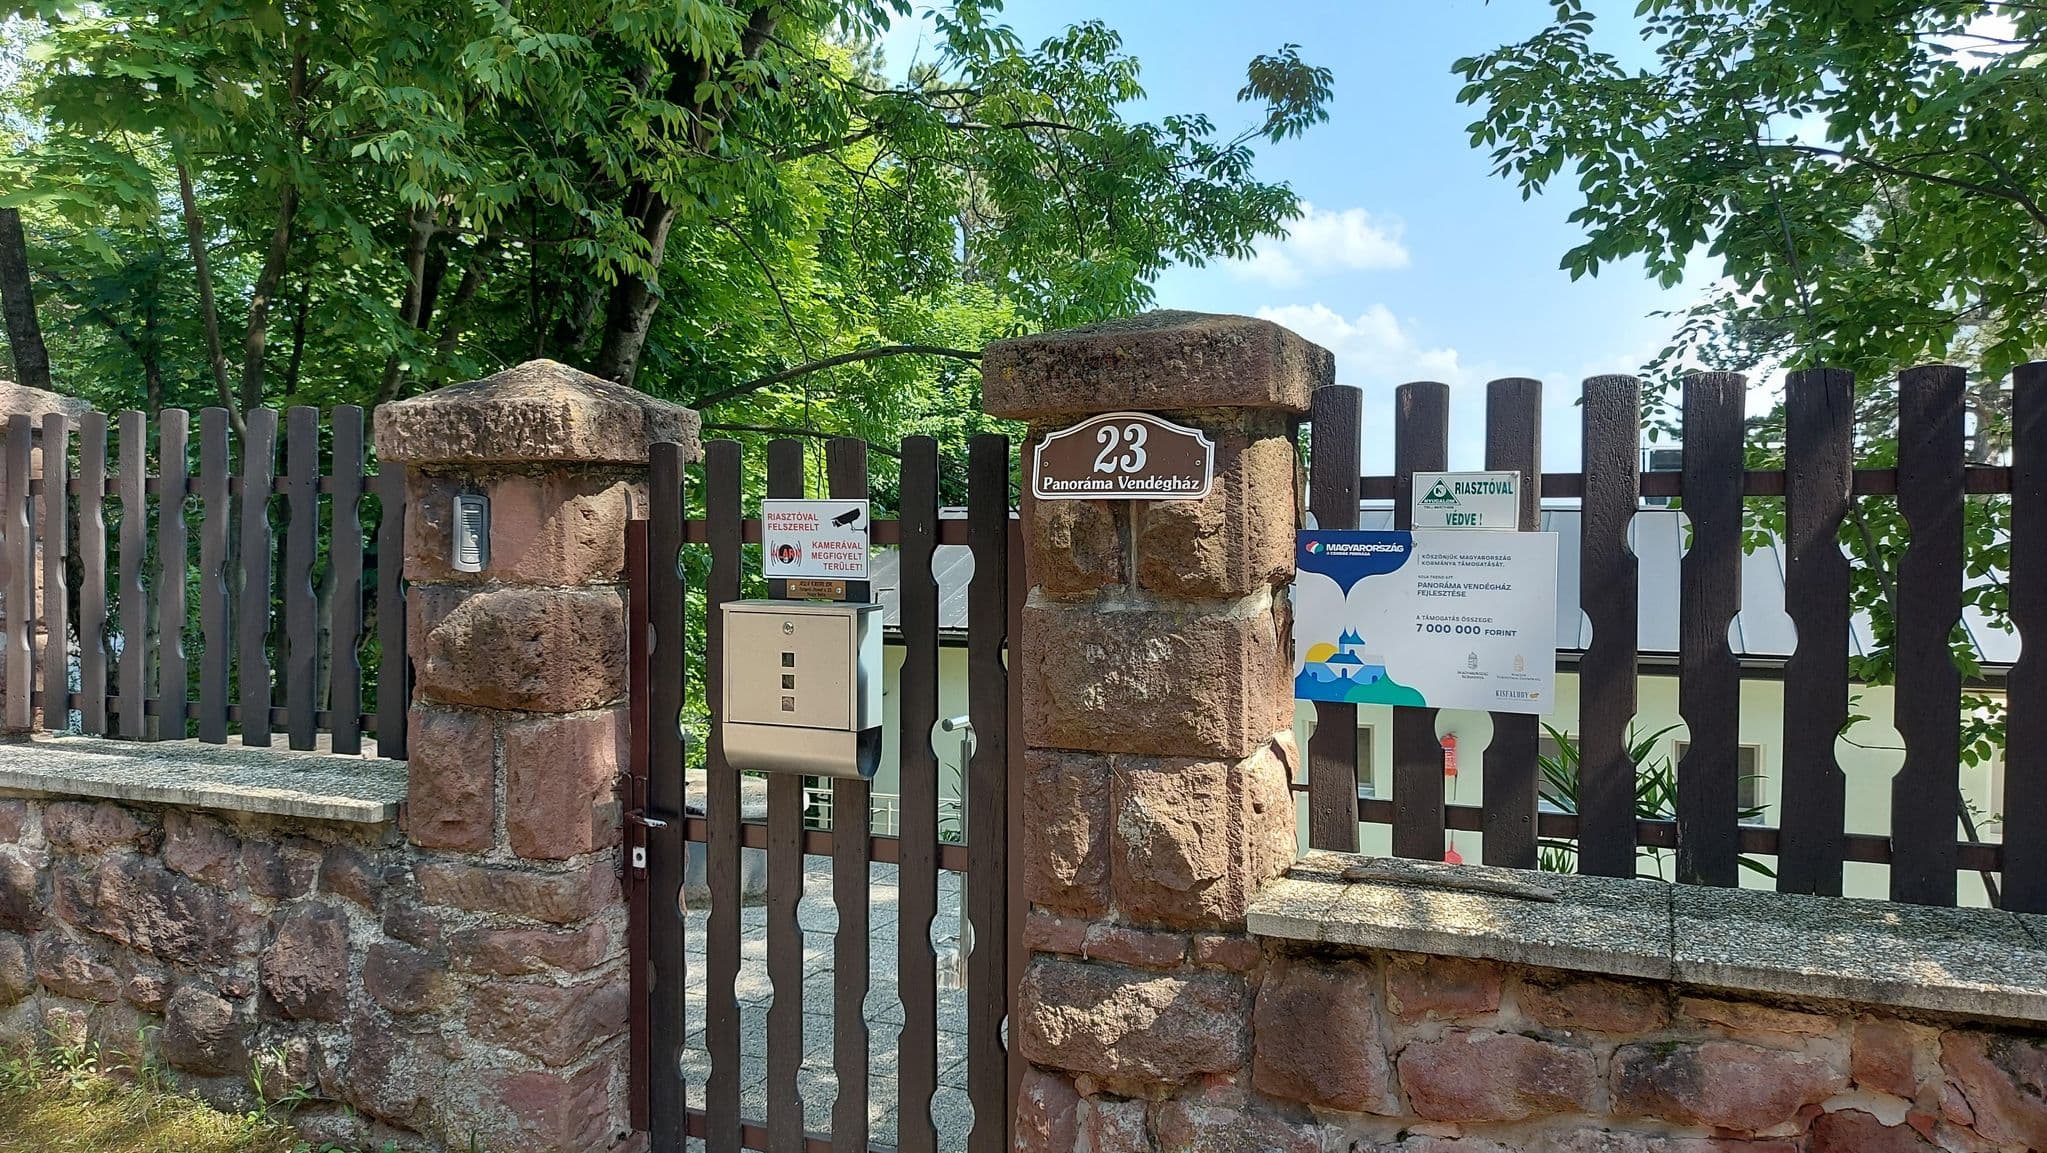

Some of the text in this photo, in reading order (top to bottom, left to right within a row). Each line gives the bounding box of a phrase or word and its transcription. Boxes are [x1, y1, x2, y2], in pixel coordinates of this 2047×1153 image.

[1093, 423, 1148, 473] 23
[1043, 475, 1200, 491] Panoráma Vendégház
[1454, 478, 1514, 495] RIASZTÓVAL
[767, 511, 819, 521] RIASZTÓVAL
[1446, 510, 1477, 526] VÉDVE
[767, 523, 820, 531] FELSZERELT
[812, 540, 863, 550] KAMERÁVAL
[1326, 541, 1404, 553] MAGYARORSZÁG
[811, 552, 863, 561] MEGFIGYELT
[823, 562, 863, 571] TERÜLET!
[1463, 582, 1512, 590] VENDÉGHÁZ
[1416, 623, 1423, 632] 7
[1426, 624, 1452, 633] 000
[1455, 625, 1481, 635] 000
